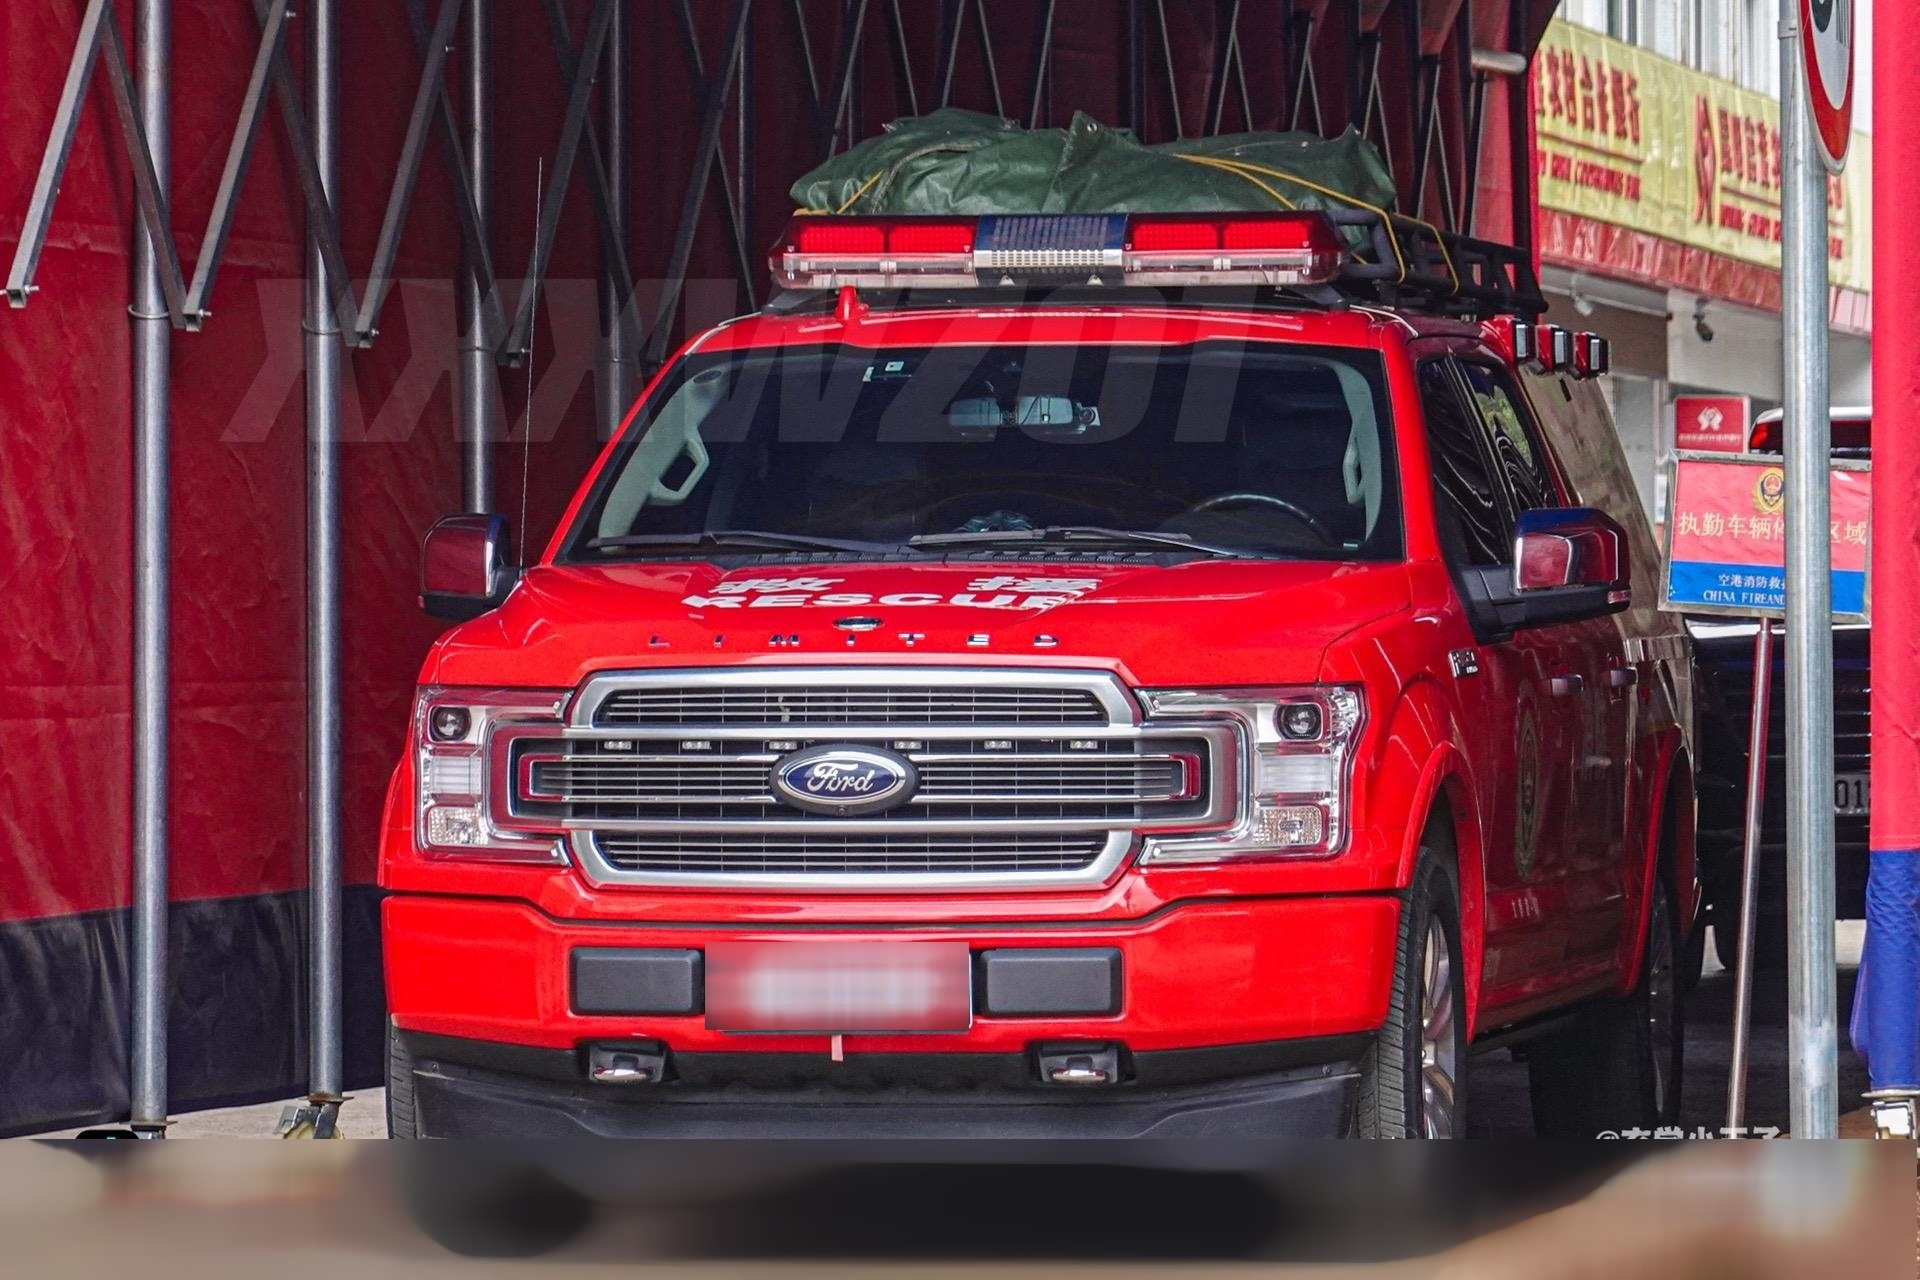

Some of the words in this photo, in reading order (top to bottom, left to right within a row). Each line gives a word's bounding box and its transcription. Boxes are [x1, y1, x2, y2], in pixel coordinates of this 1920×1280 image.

[1718, 573, 1785, 590] 空港消防救
[1703, 590, 1735, 602] CHINA
[648, 633, 1060, 649] LIMITED
[807, 762, 876, 792] Ford
